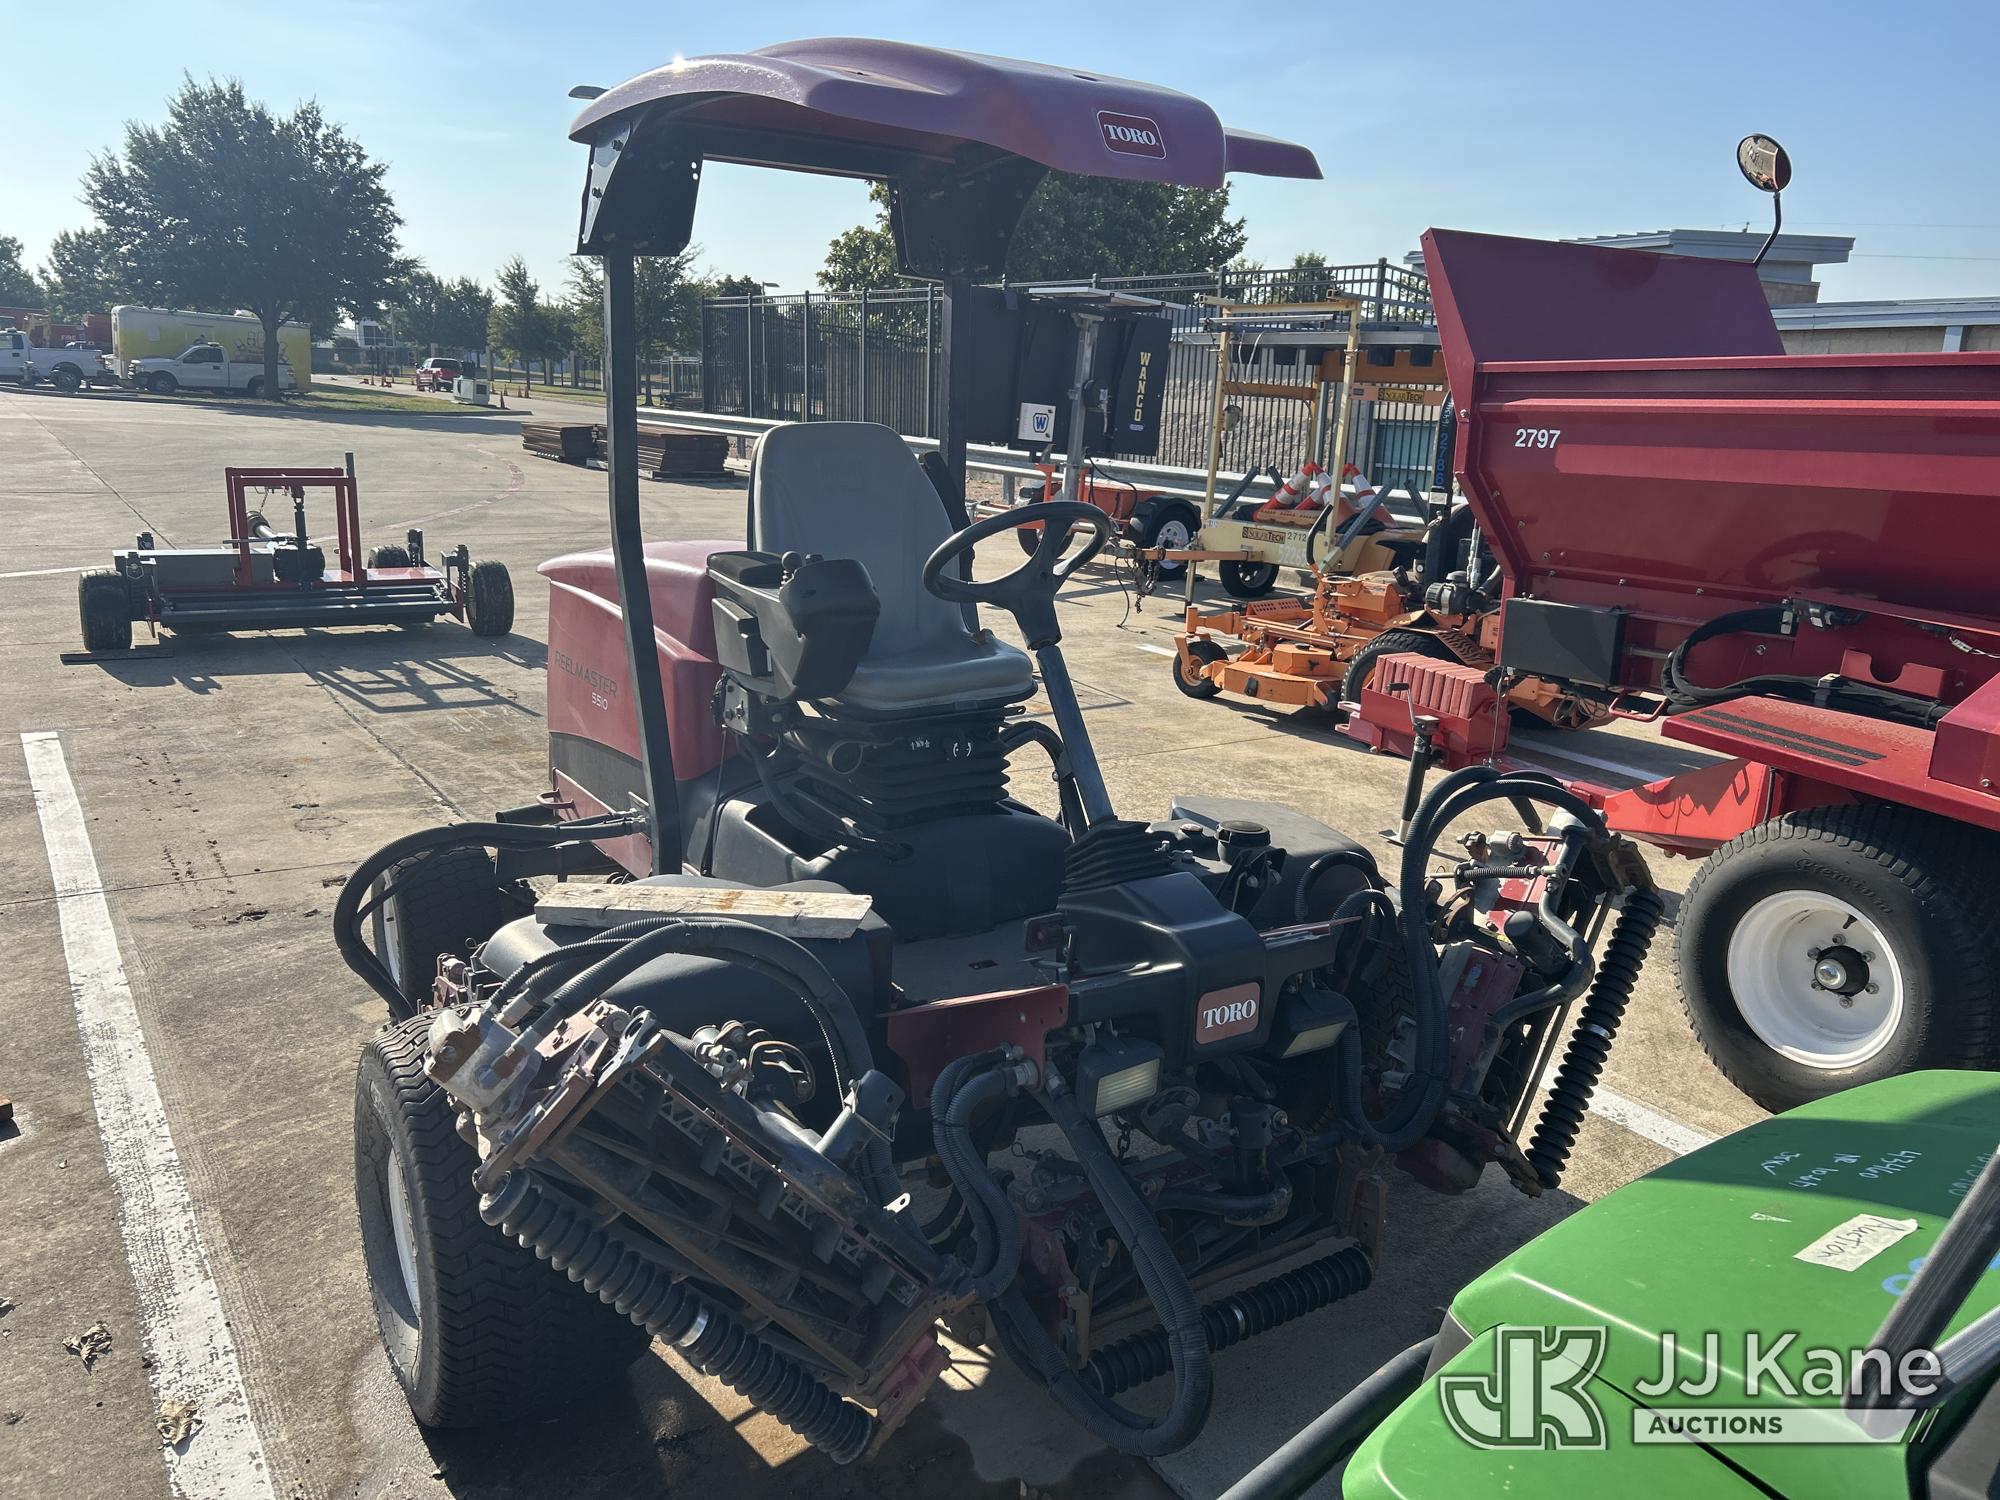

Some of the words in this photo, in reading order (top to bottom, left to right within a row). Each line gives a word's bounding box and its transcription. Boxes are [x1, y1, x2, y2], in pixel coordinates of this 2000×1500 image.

[1104, 124, 1157, 146] TORO
[1134, 351, 1151, 422] WANCO
[1035, 416, 1048, 430] W
[1515, 428, 1561, 449] 2797
[1435, 433, 1449, 486] 2786
[1287, 531, 1307, 543] 2712
[555, 650, 618, 698] REELMASTER
[591, 691, 609, 710] 5510
[1203, 999, 1257, 1029] TORO
[1816, 1216, 1905, 1259] Auction
